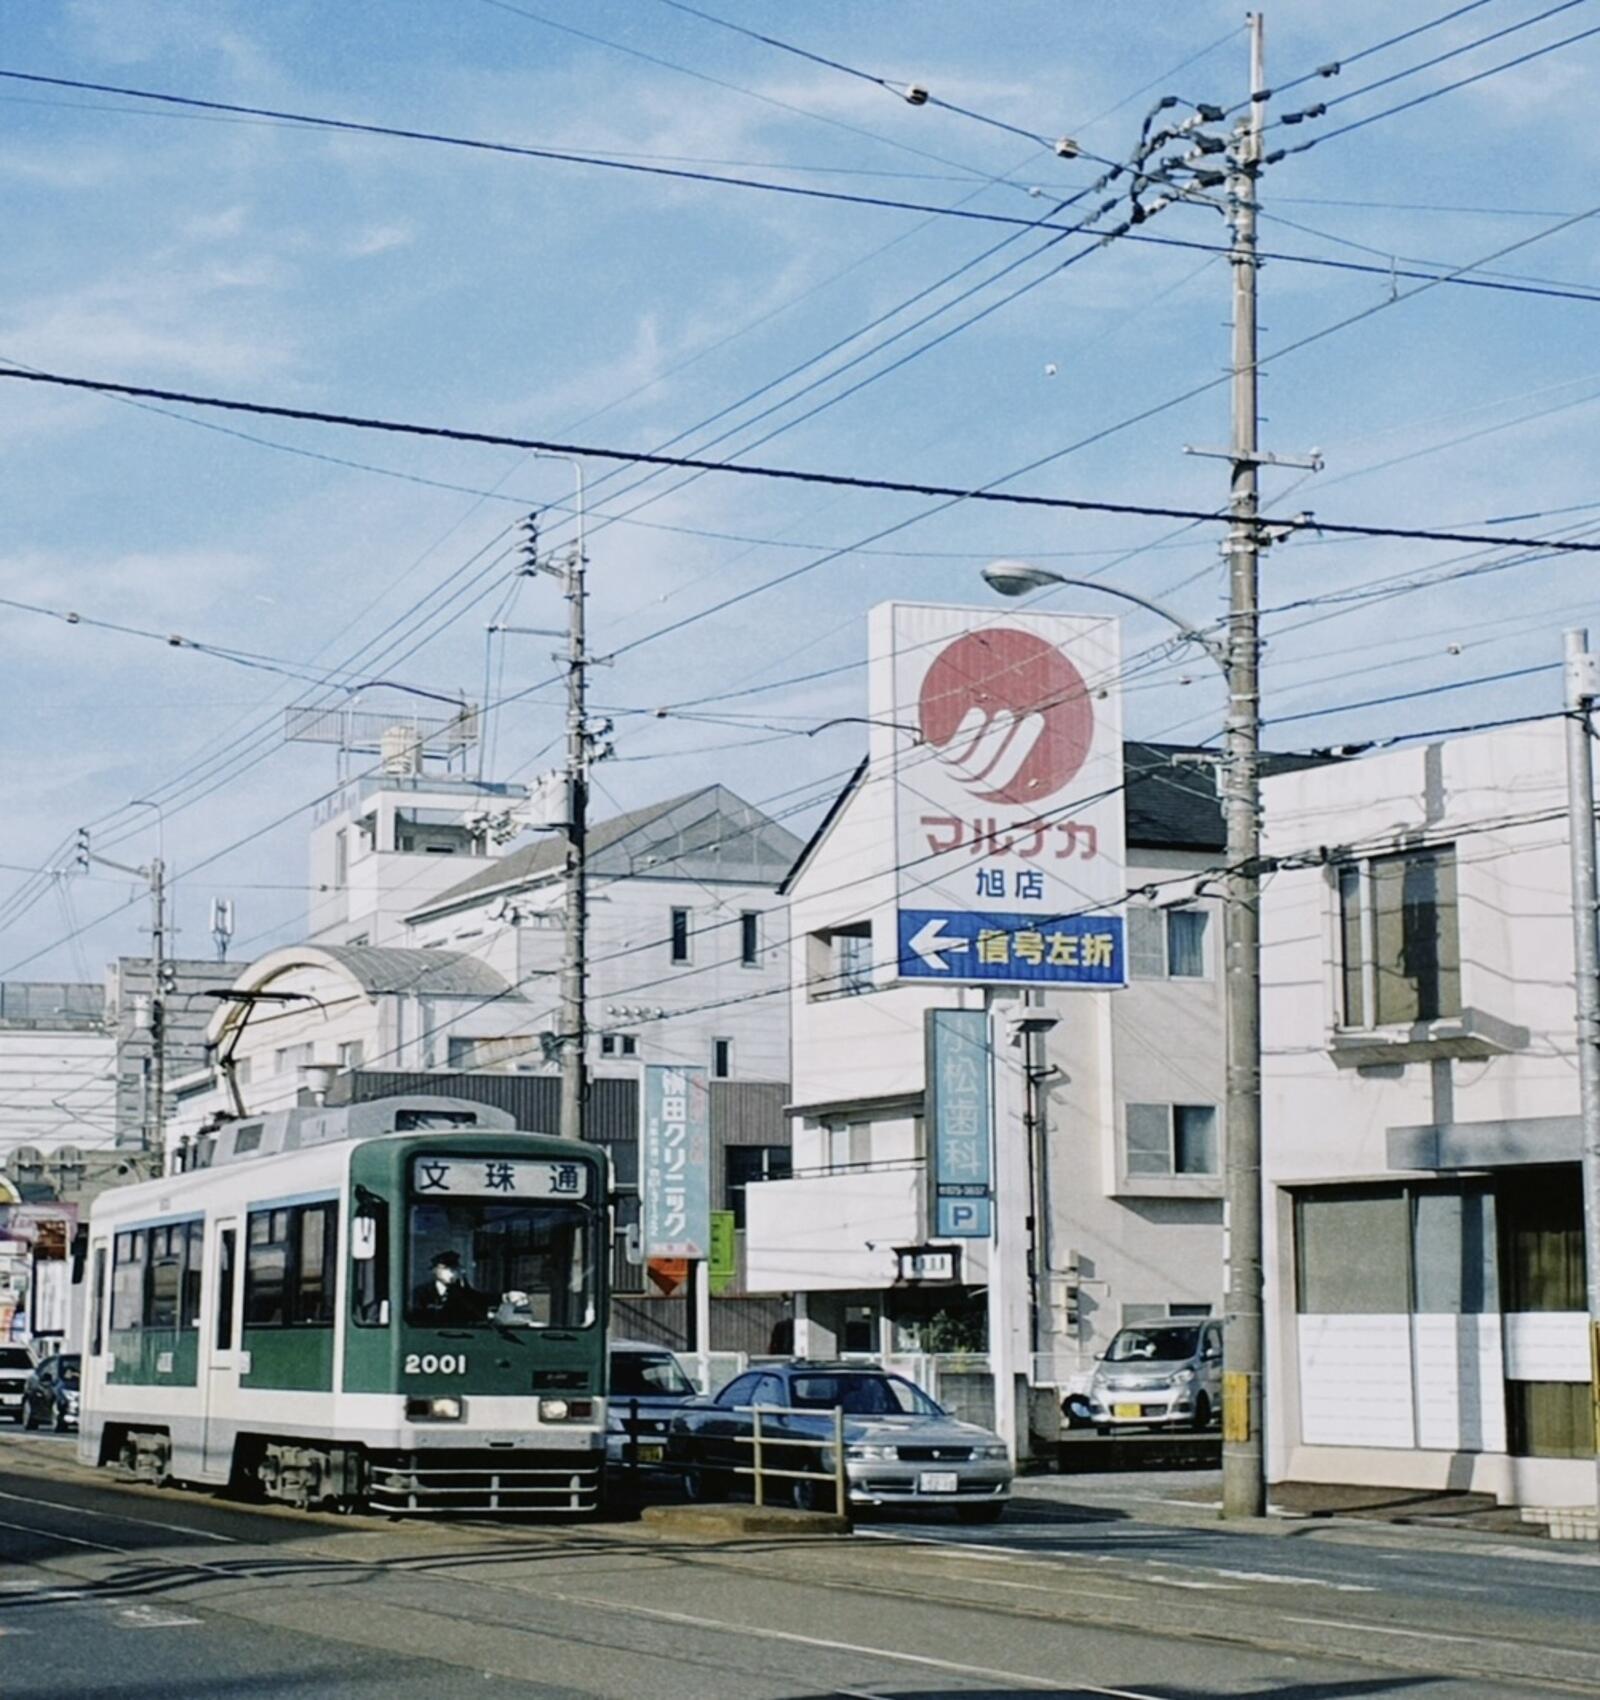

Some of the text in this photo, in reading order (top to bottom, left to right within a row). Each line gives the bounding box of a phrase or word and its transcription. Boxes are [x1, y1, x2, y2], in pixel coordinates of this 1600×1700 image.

[920, 816, 1098, 860] マルナカ
[976, 868, 1043, 899] 旭店
[977, 929, 1114, 968] 信号左折
[943, 1020, 982, 1177] 小松歯科
[419, 1160, 579, 1193] 文珠通
[953, 1206, 973, 1227] P
[404, 1354, 467, 1375] 2001
